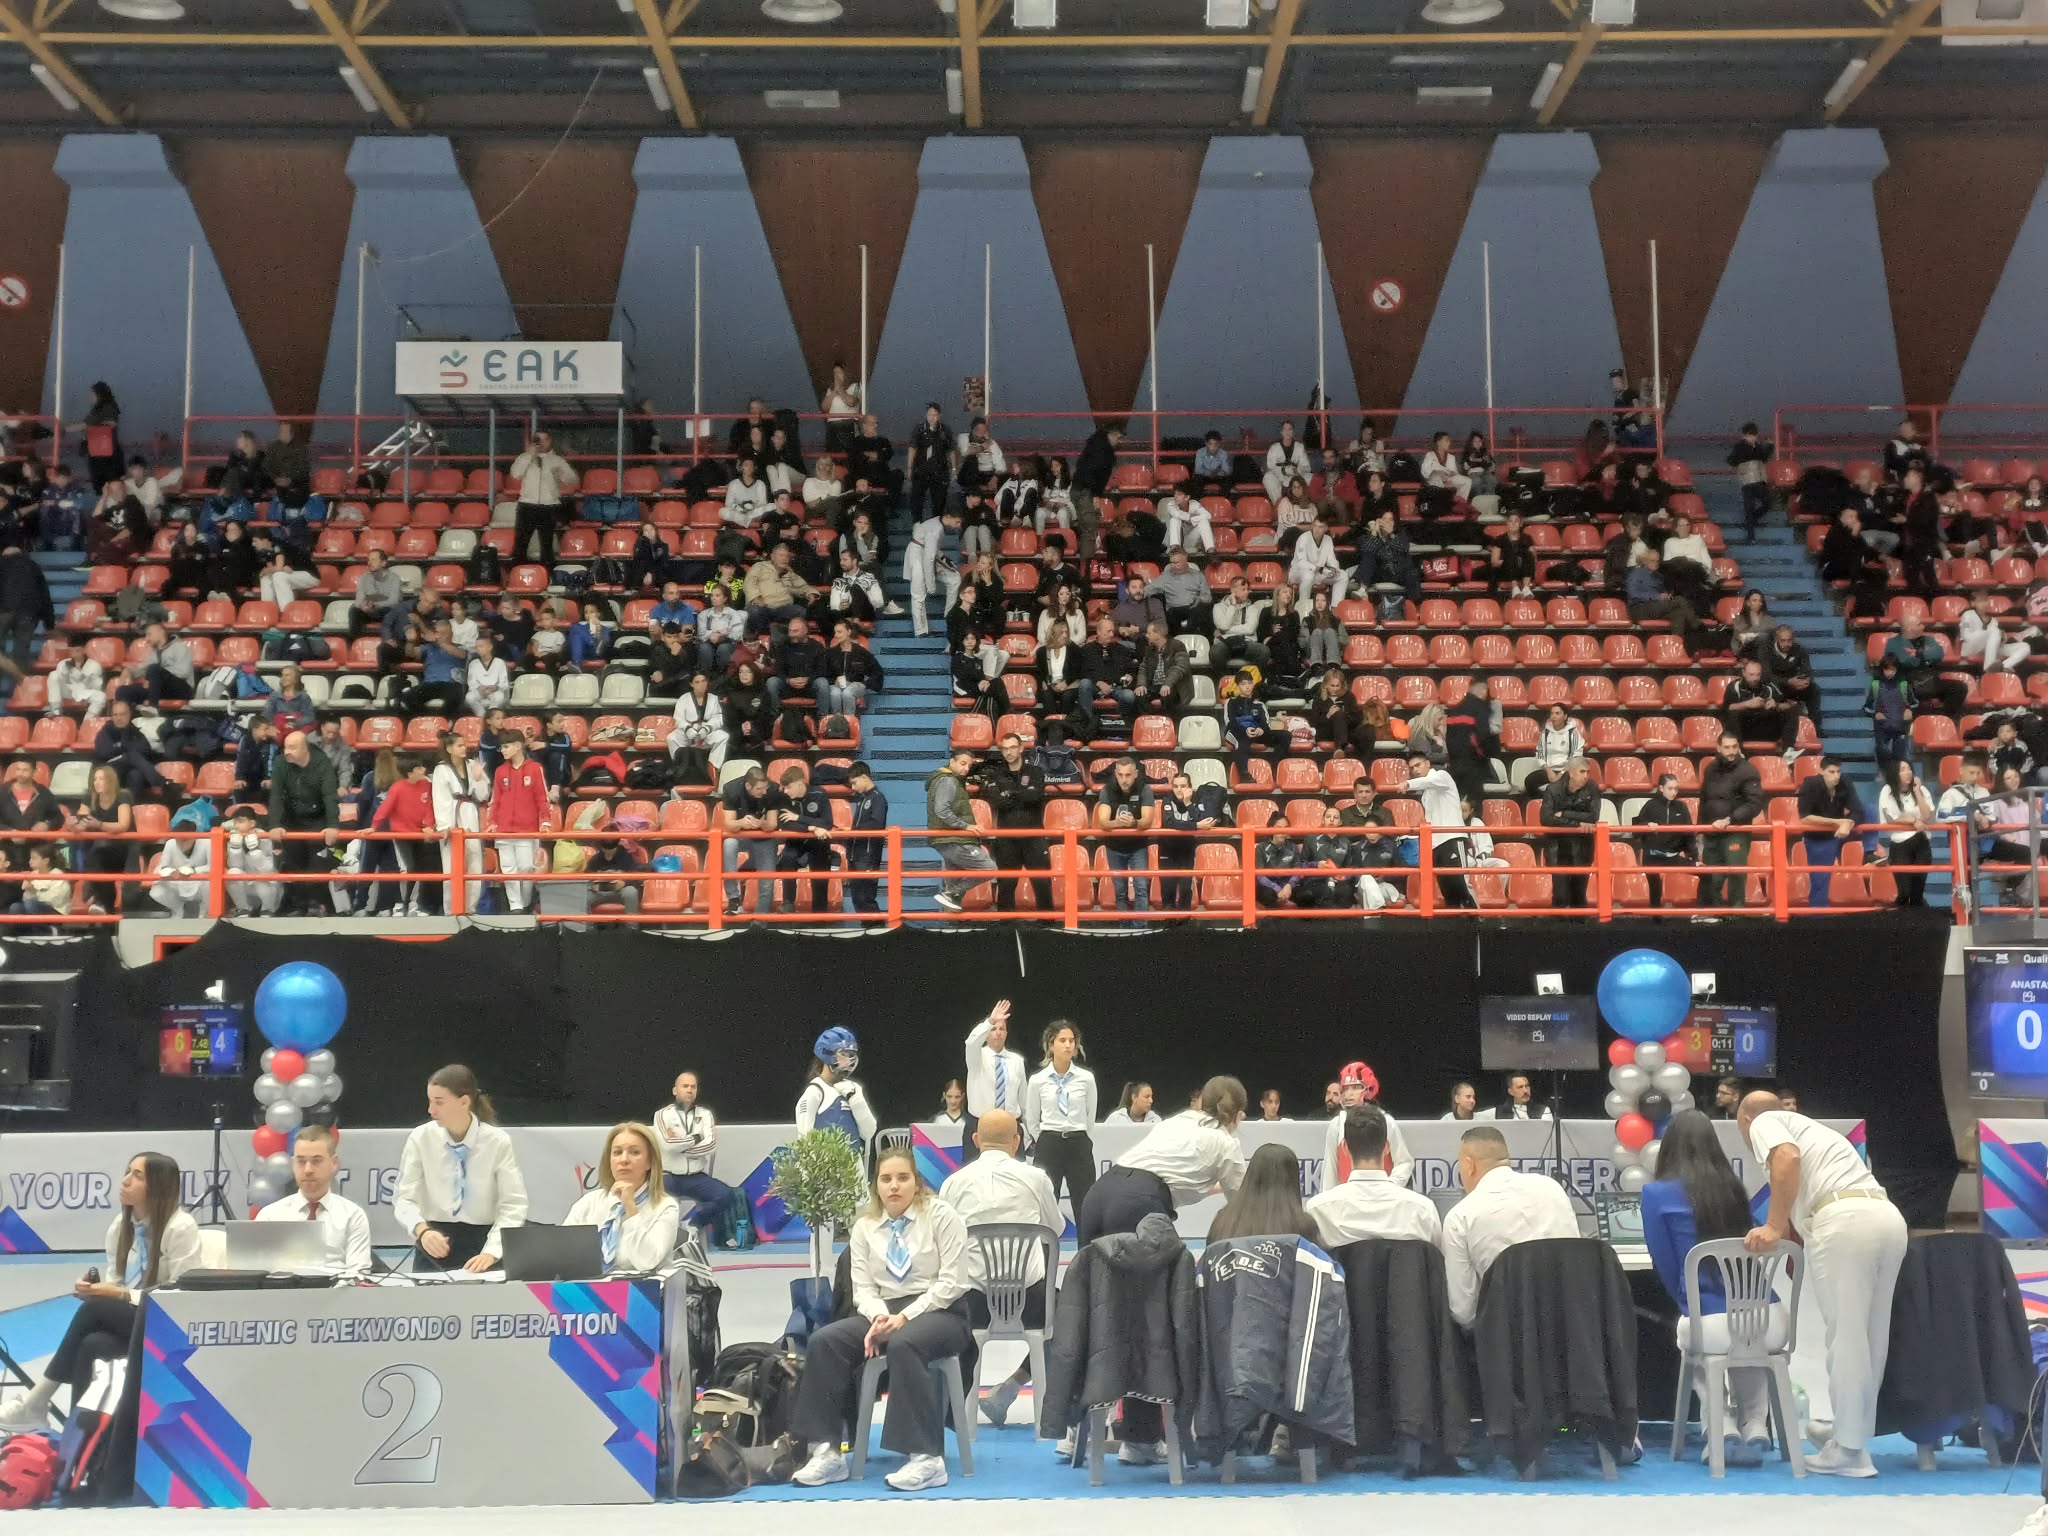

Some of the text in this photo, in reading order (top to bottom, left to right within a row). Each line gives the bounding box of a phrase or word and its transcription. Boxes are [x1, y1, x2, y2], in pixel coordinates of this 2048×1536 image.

[2010, 980, 2048, 989] ANASTA
[1506, 1013, 1527, 1021] VIDEO
[1527, 1013, 1552, 1021] REPLAY
[1691, 1030, 1702, 1050] 3
[2016, 1009, 2043, 1051] 0
[175, 1031, 186, 1053] 6
[214, 1031, 226, 1053] 4
[1711, 1038, 1732, 1049] 0:11
[1742, 1032, 1754, 1053] 0
[1719, 1064, 1726, 1073] 3
[1979, 1078, 1988, 1091] 0
[9, 1172, 112, 1210] YOUR
[188, 1312, 619, 1347] HELLENIC TAEKWONDO FEDERATION
[354, 1363, 443, 1486] 2
